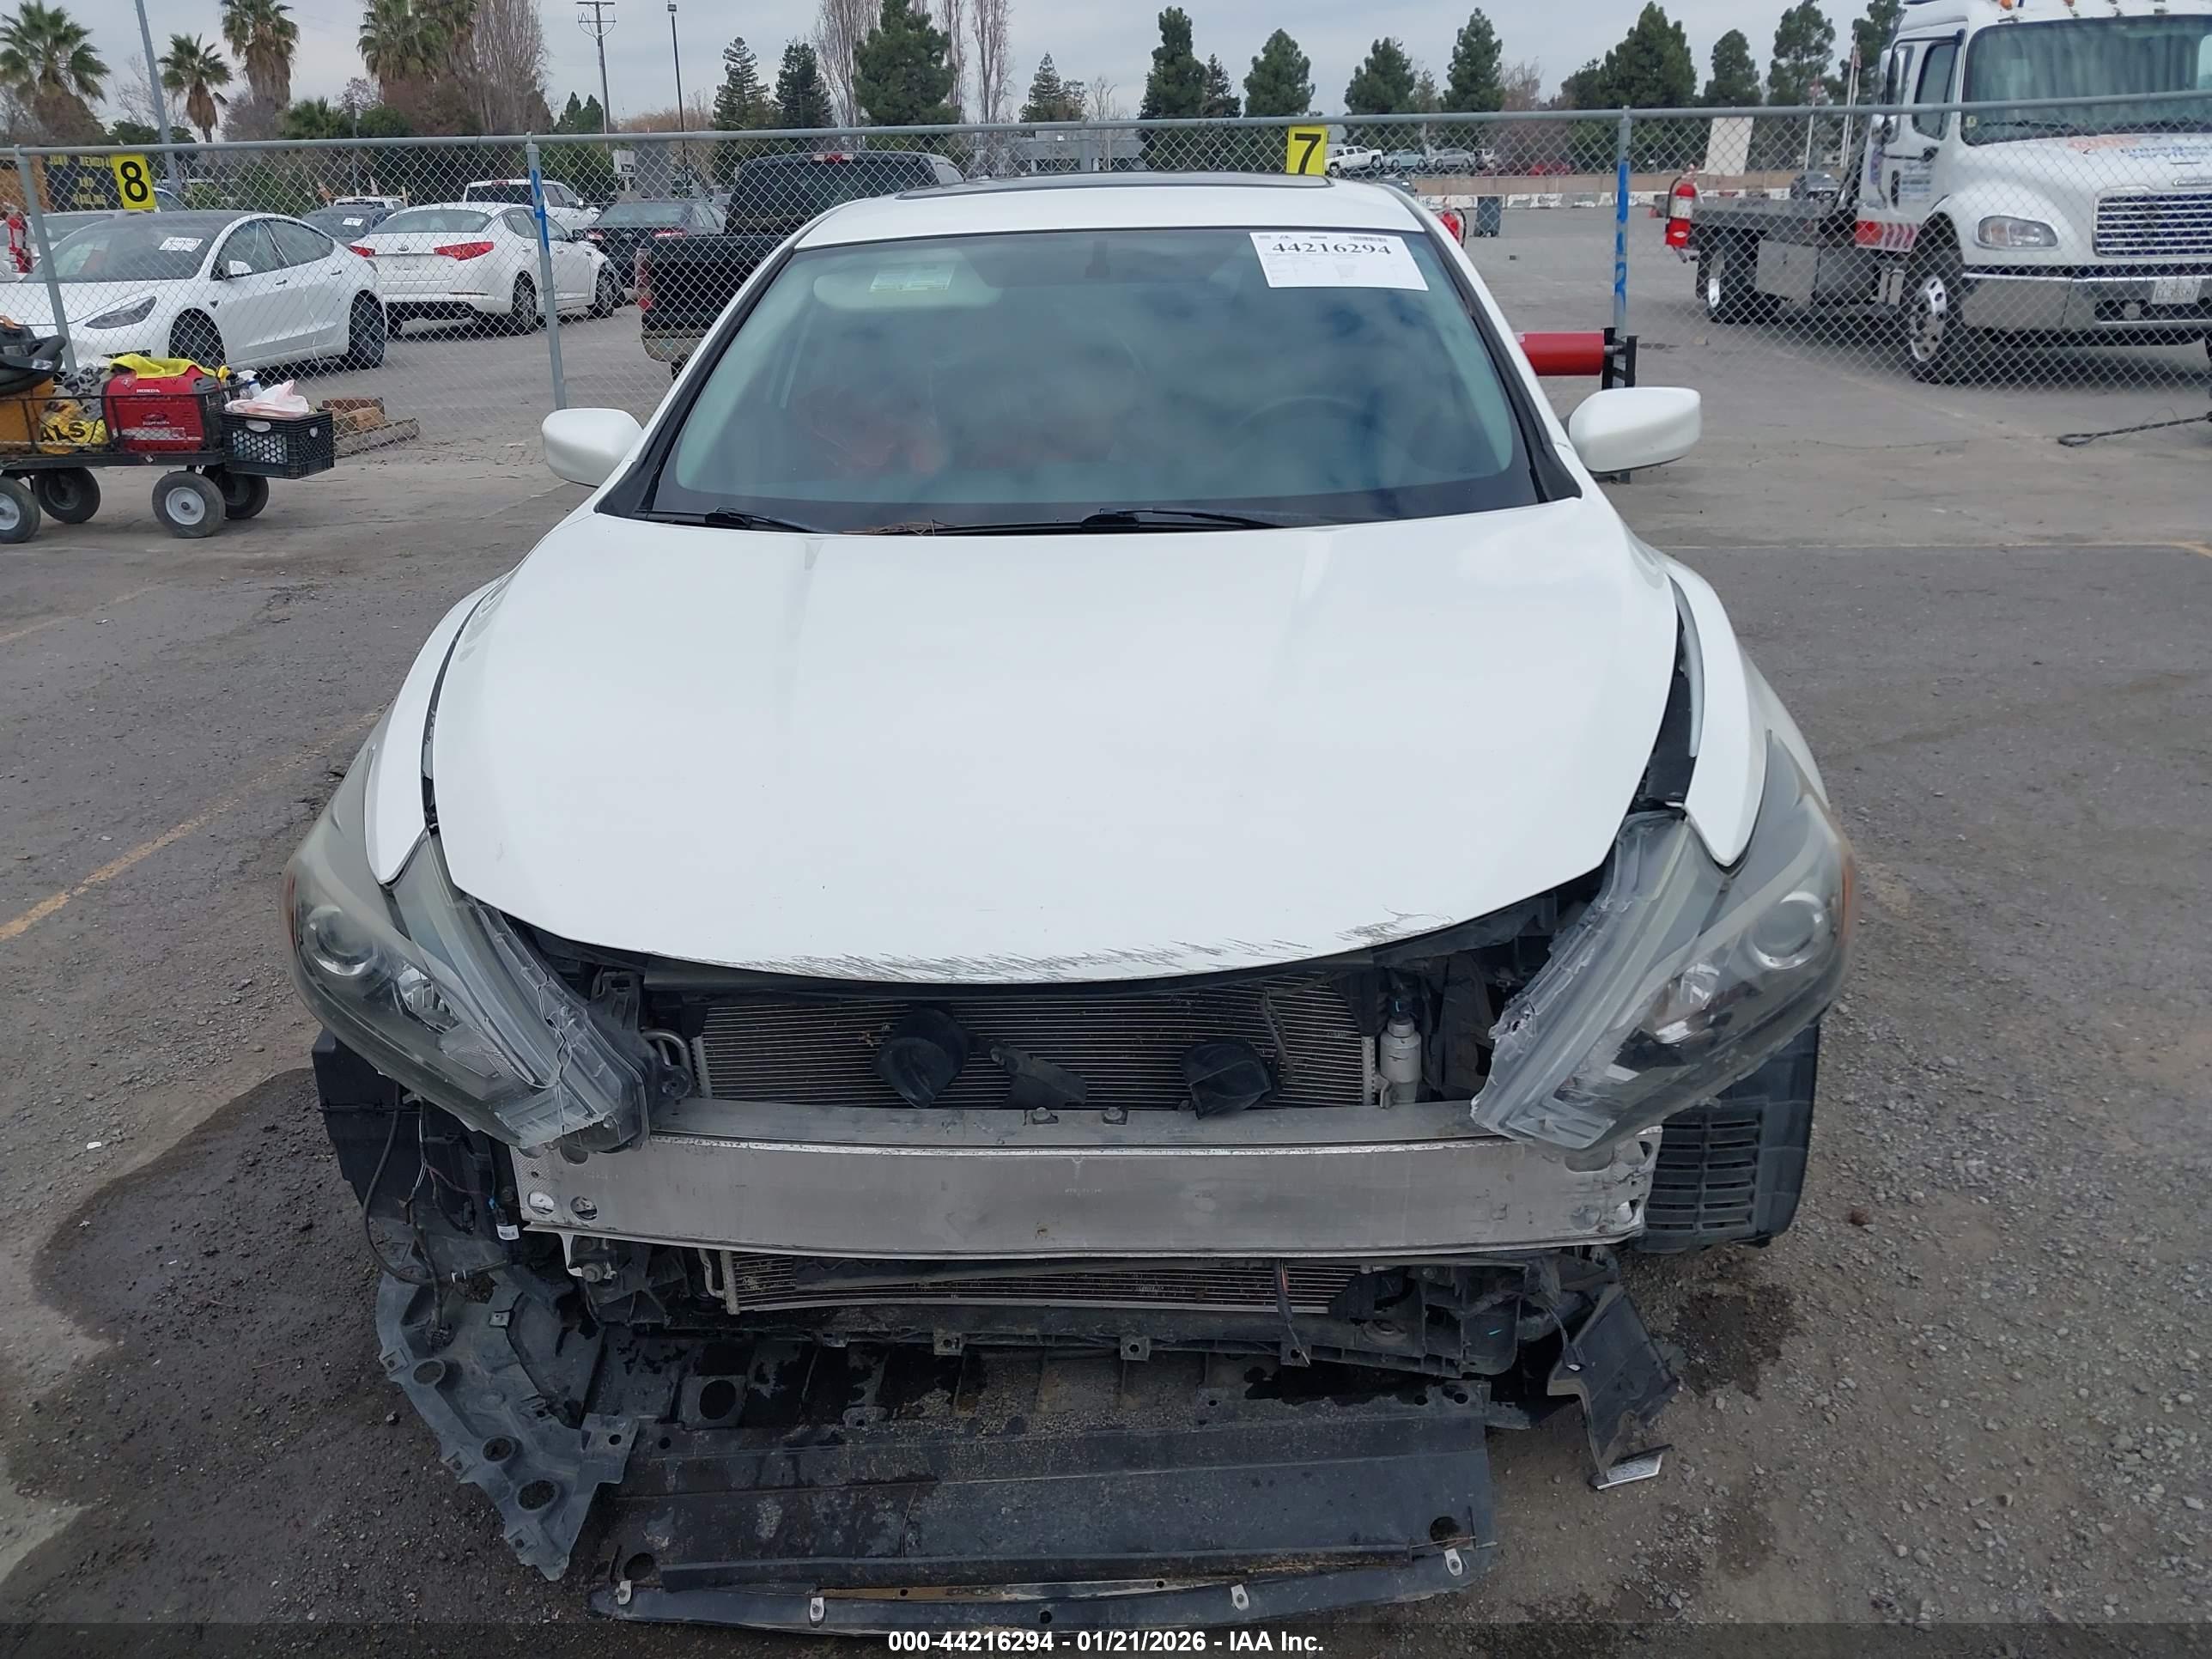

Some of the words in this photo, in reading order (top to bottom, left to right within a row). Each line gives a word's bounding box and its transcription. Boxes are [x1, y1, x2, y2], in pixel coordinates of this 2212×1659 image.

[1294, 133, 1322, 174] 7
[120, 161, 149, 203] 8
[1272, 242, 1392, 255] 44216294
